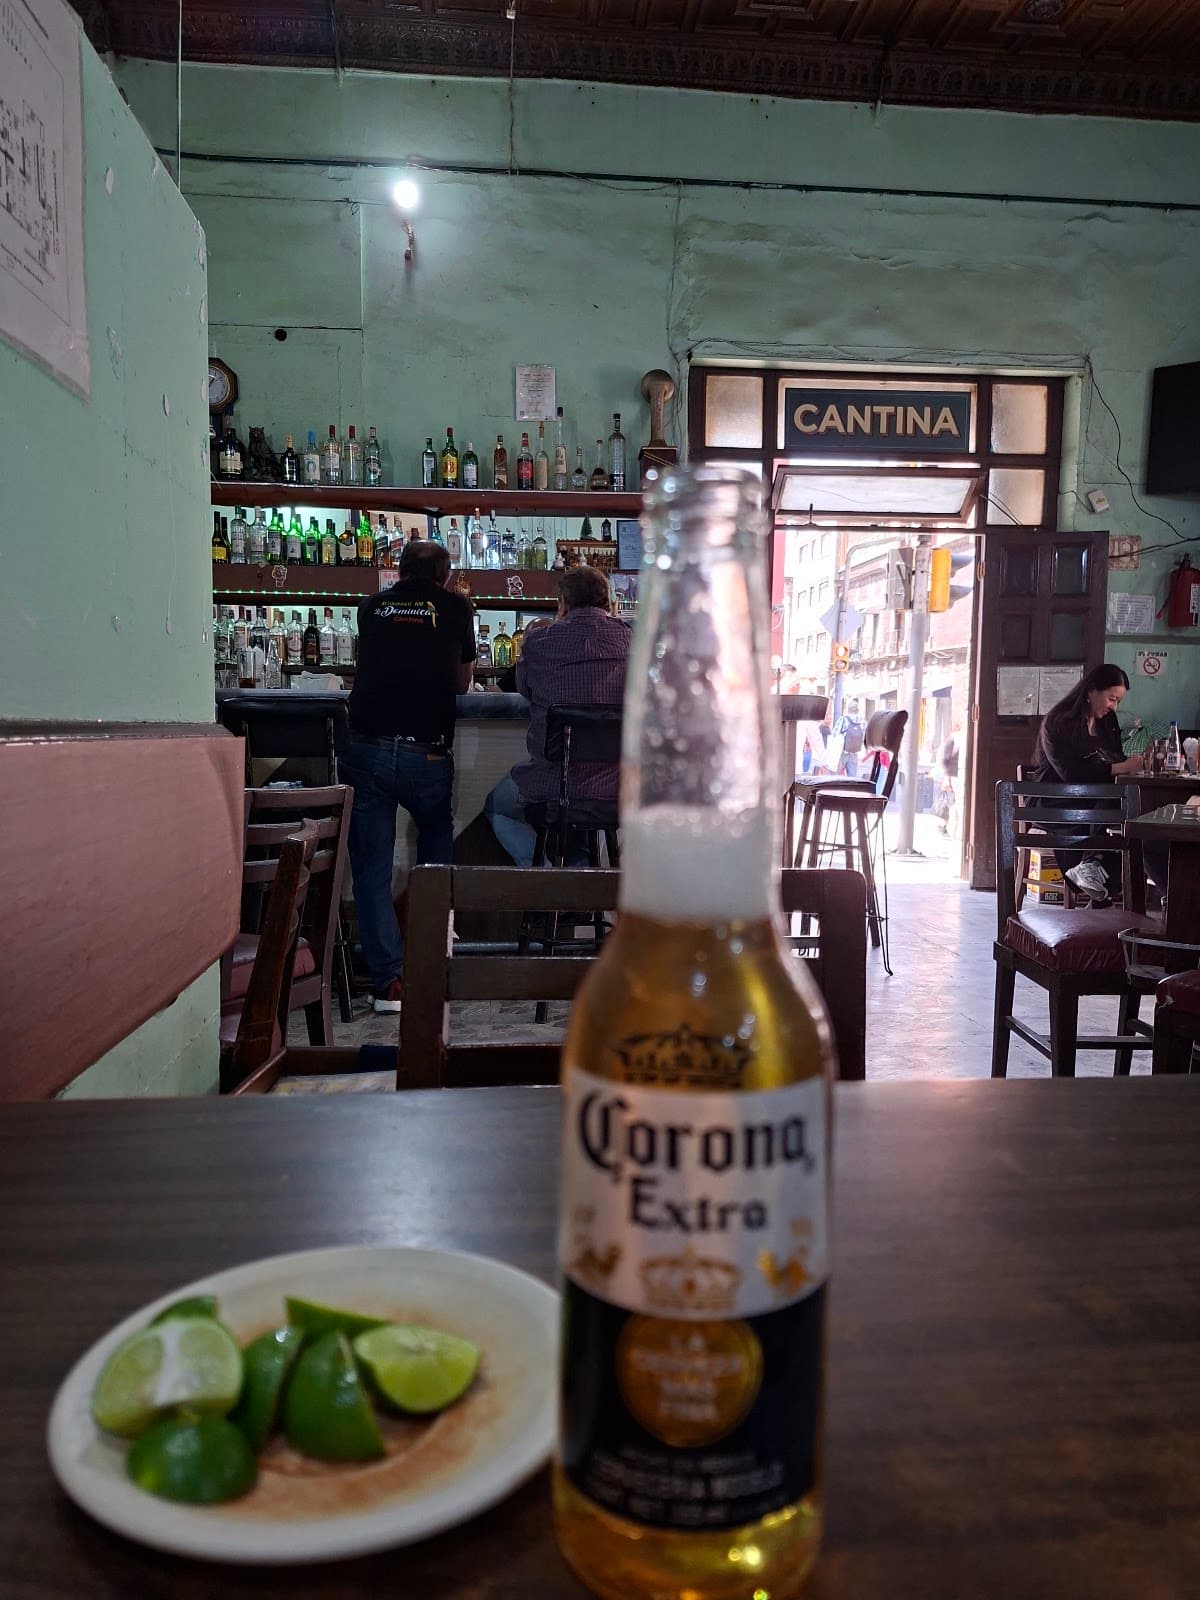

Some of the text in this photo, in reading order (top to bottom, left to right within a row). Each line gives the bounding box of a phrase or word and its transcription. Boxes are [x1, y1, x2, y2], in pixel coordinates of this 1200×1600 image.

[794, 403, 960, 438] CANTINA
[578, 1091, 815, 1182] Corona
[629, 1175, 768, 1231] Extra
